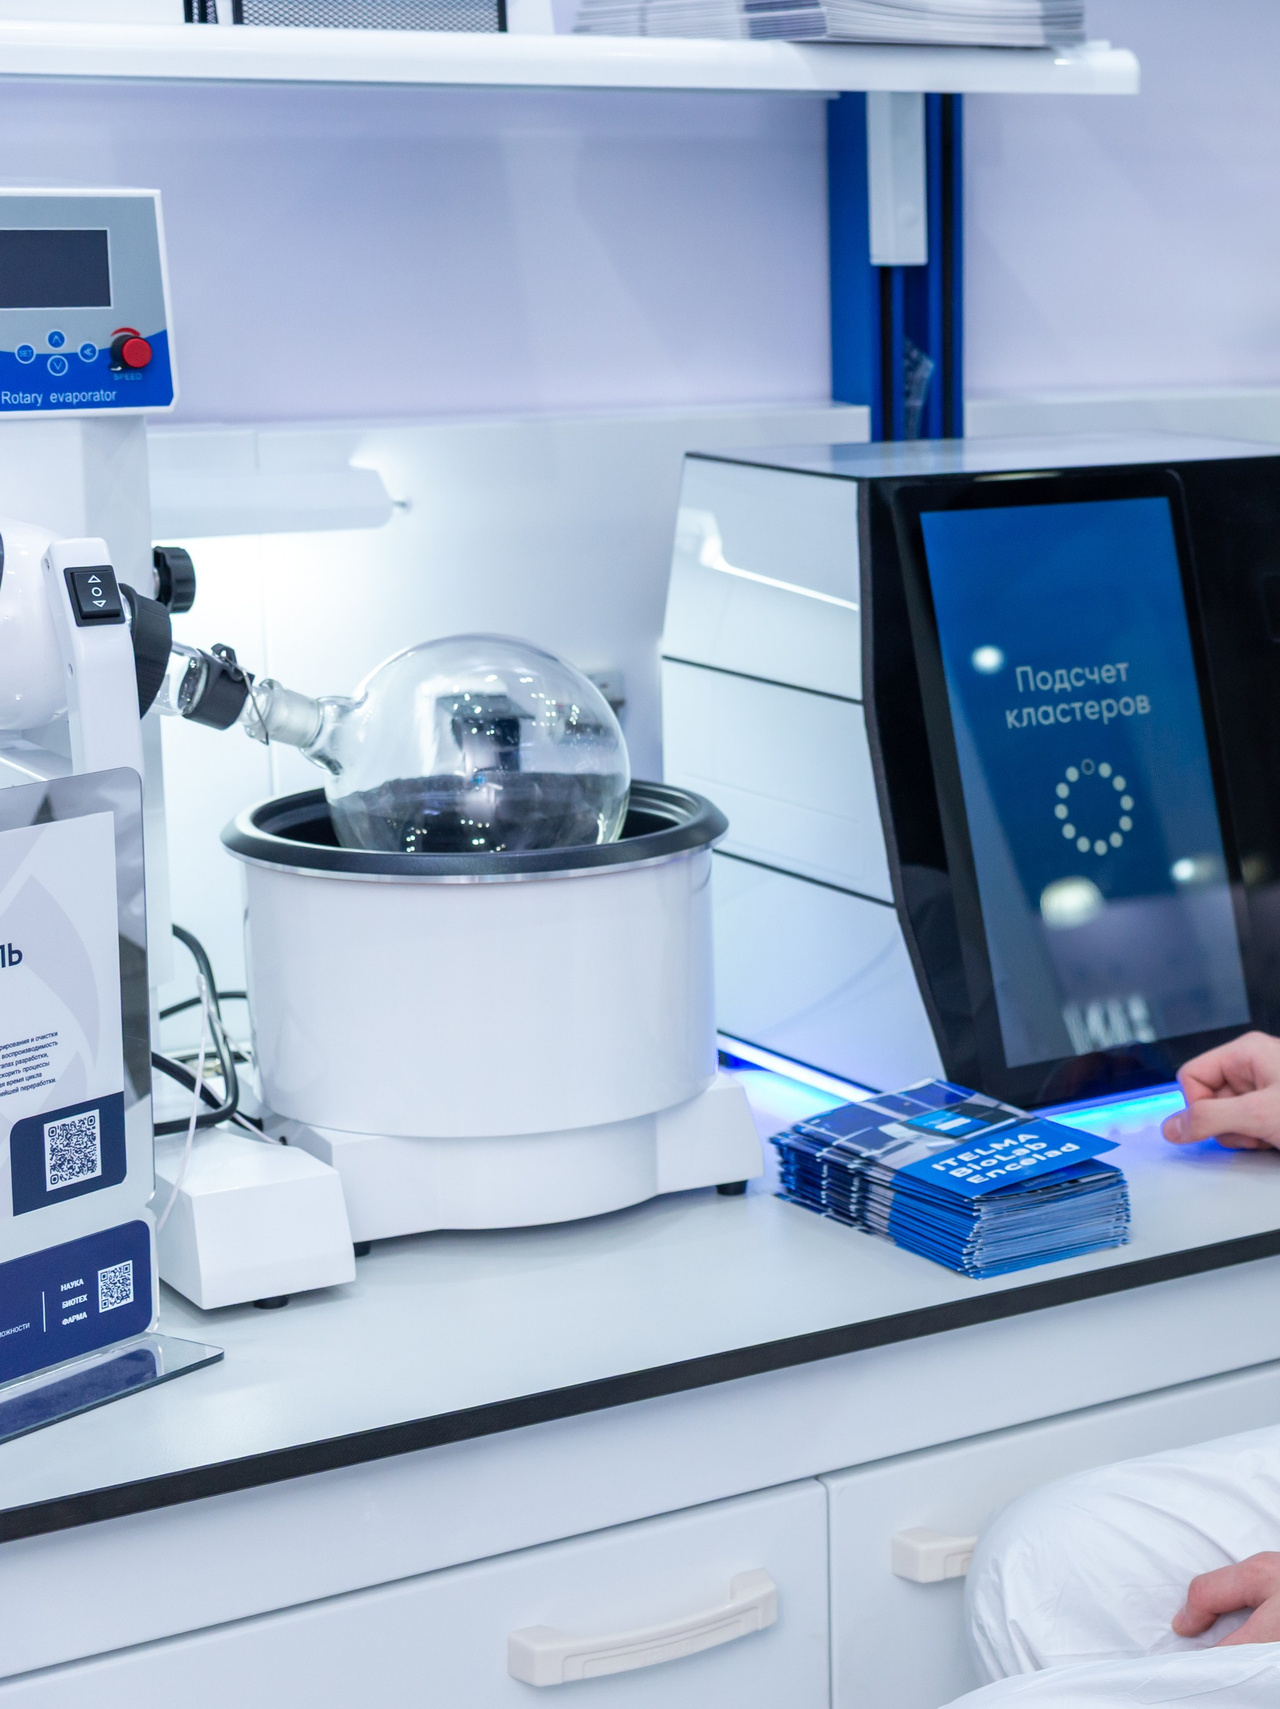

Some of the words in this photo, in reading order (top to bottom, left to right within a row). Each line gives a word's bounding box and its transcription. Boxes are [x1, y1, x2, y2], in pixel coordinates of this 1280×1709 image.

[19, 349, 32, 358] SET
[113, 373, 142, 381] SPEED
[1, 390, 43, 407] Rotary
[50, 389, 117, 405] evaporator
[1015, 662, 1129, 694] Подсчет
[1005, 694, 1151, 729] кластеров
[36, 1032, 58, 1041] очистки
[2, 1041, 58, 1059] воспроизводимость
[23, 1061, 50, 1072] процессы
[6, 1077, 24, 1087] время
[25, 1072, 42, 1081] цикла
[931, 1133, 1040, 1171] ITELMA
[948, 1142, 1047, 1178] BioLab
[966, 1142, 1080, 1184] Encelad
[60, 1278, 84, 1292] НАУКА
[62, 1294, 88, 1309] БИОТЕХ
[61, 1312, 87, 1325] ФАРМА
